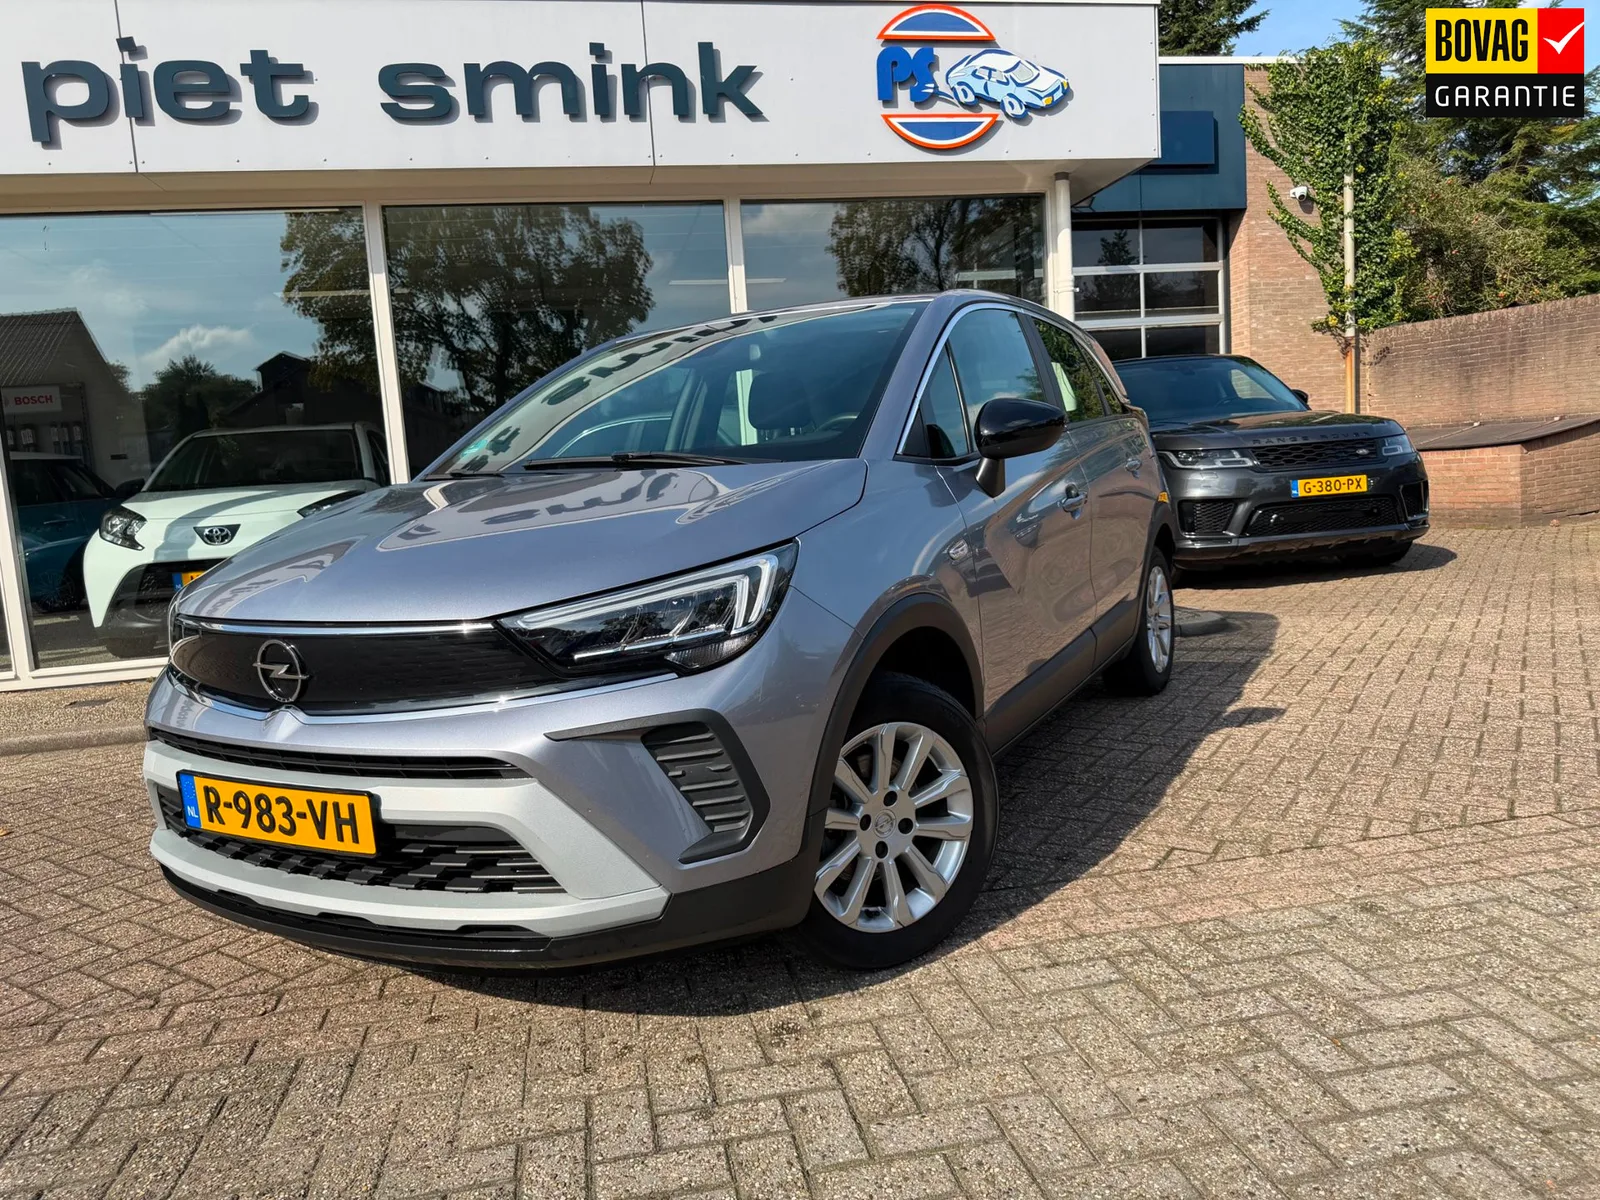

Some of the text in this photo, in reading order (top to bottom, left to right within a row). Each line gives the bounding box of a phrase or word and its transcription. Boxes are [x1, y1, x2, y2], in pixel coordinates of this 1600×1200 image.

[21, 36, 763, 142] piet smink
[14, 395, 54, 406] BOSCH
[1252, 435, 1310, 445] RANGE
[1303, 477, 1363, 494] G-380-PX
[187, 785, 360, 845] NL R-983-VH
